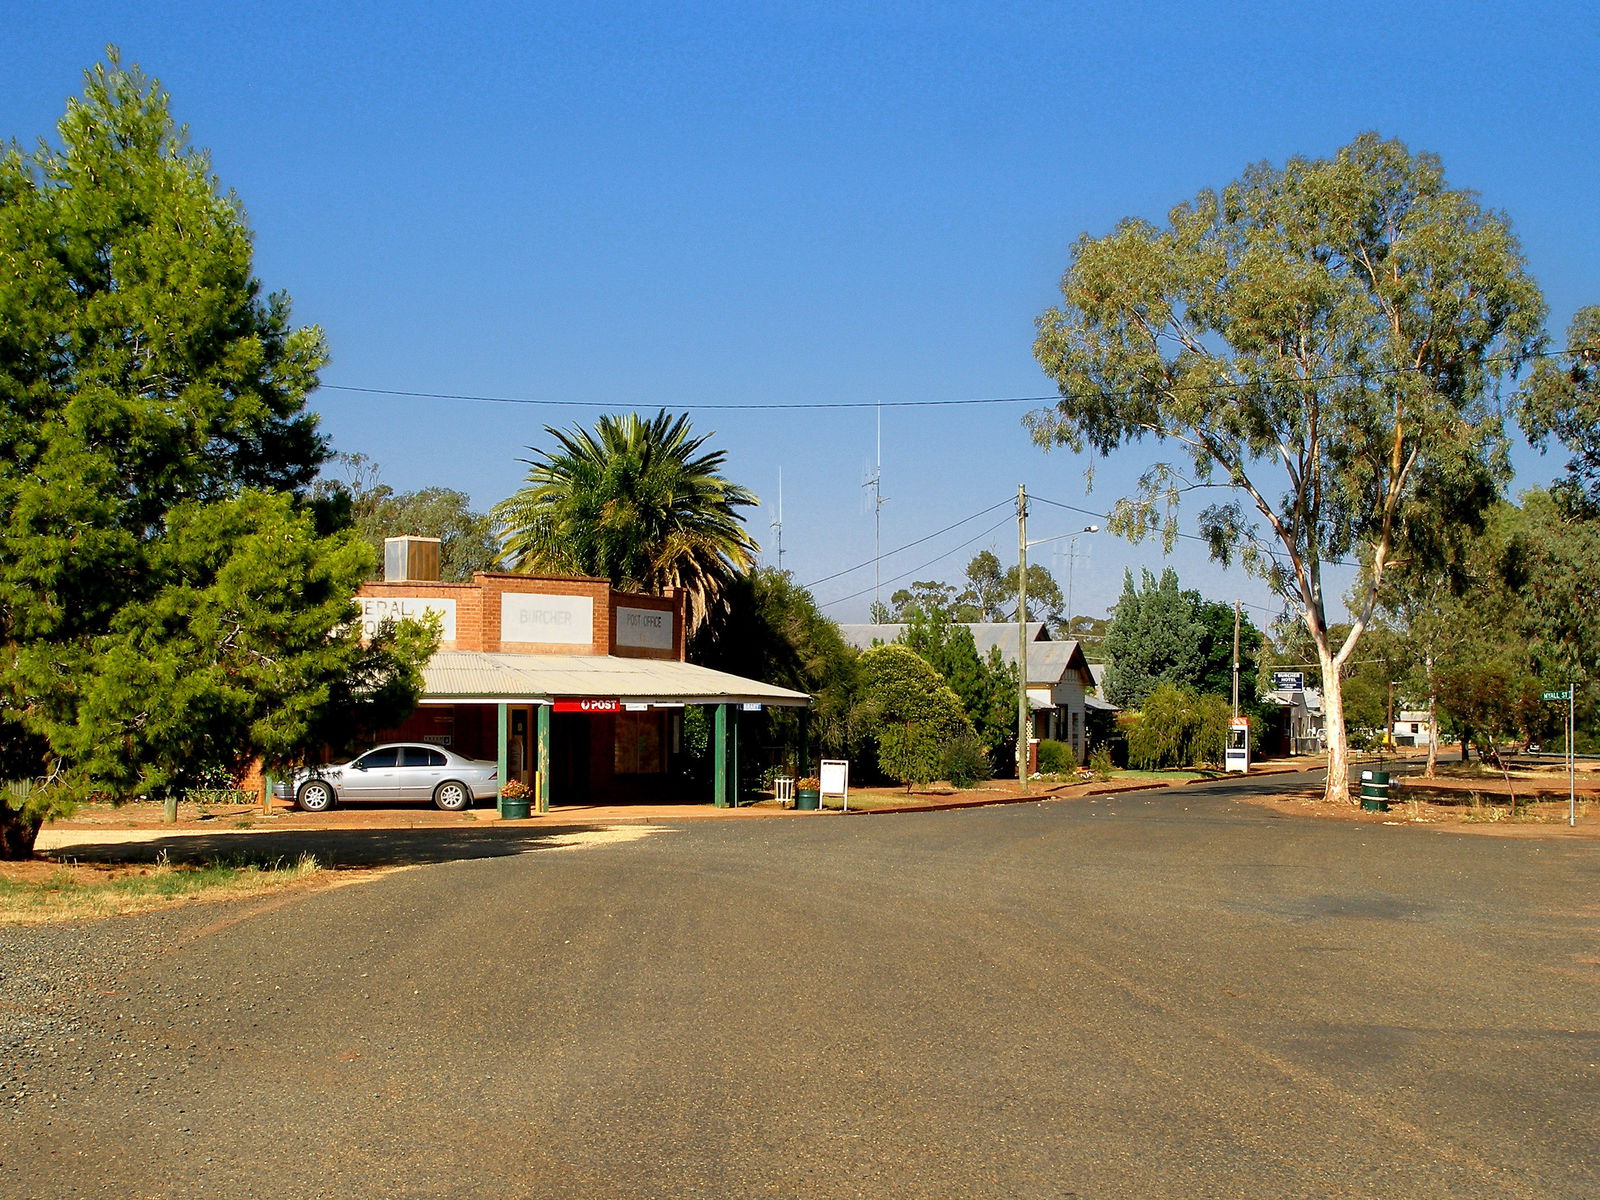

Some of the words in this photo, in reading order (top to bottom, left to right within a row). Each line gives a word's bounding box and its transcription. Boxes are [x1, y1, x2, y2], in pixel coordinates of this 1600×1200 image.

[519, 608, 573, 625] BURCHER
[626, 613, 641, 626] POST
[643, 615, 662, 628] OFFICE
[591, 700, 617, 710] POST
